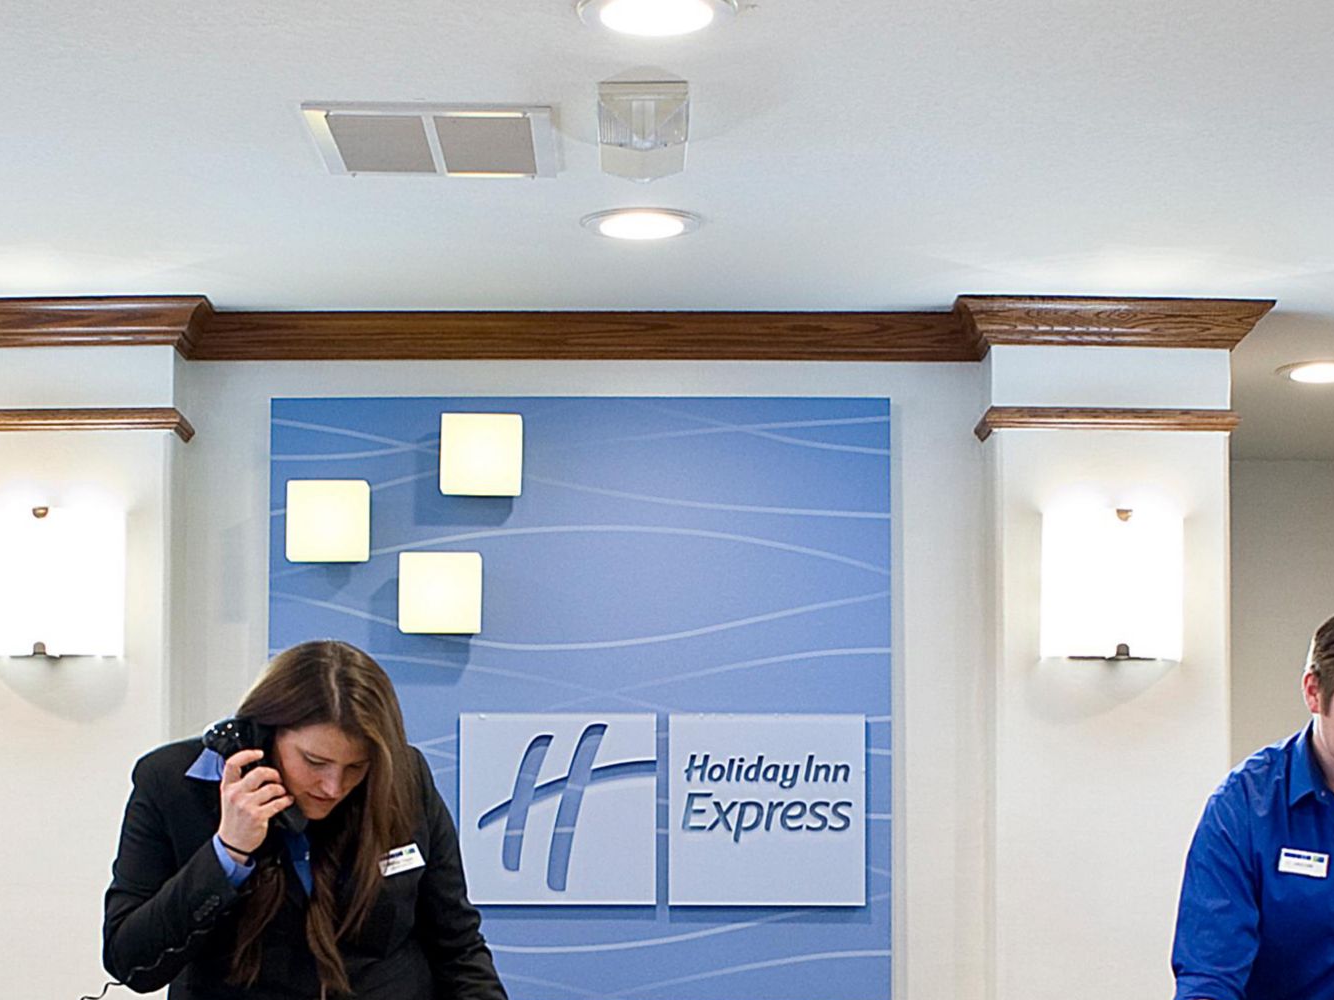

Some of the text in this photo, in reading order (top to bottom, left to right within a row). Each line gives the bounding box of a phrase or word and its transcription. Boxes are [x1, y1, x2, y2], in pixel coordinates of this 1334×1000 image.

[684, 753, 850, 789] Holiday Inn
[681, 791, 853, 843] Express
